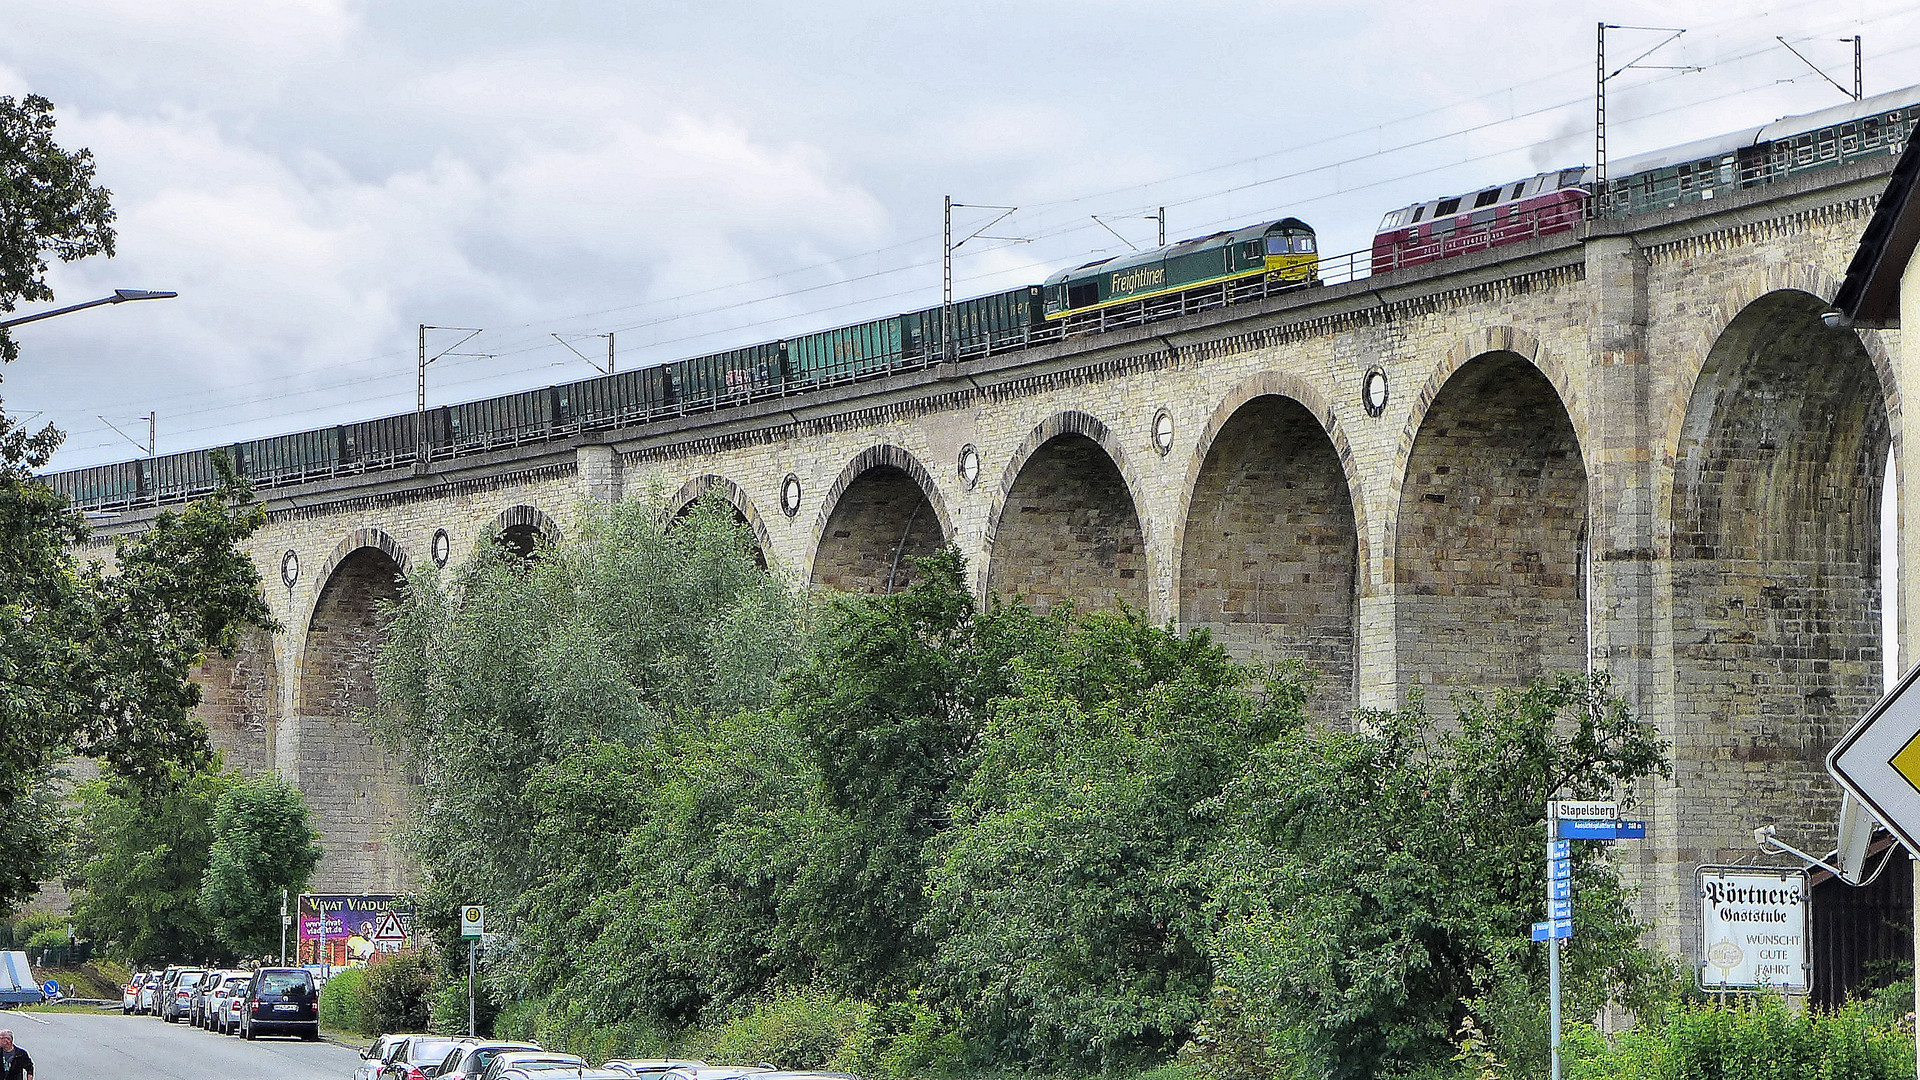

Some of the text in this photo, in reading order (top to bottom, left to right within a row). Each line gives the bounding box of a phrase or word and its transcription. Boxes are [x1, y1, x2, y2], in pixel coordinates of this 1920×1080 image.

[1111, 267, 1165, 294] Freightliner
[1560, 804, 1615, 818] Stapelsberg
[1706, 882, 1801, 910] Pörtners
[310, 898, 344, 911] VVAT
[1720, 908, 1787, 923] Gaststube
[1745, 933, 1800, 946] WÜNSCHT
[1759, 949, 1788, 960] GUTE
[1757, 964, 1790, 975] FAHRT
